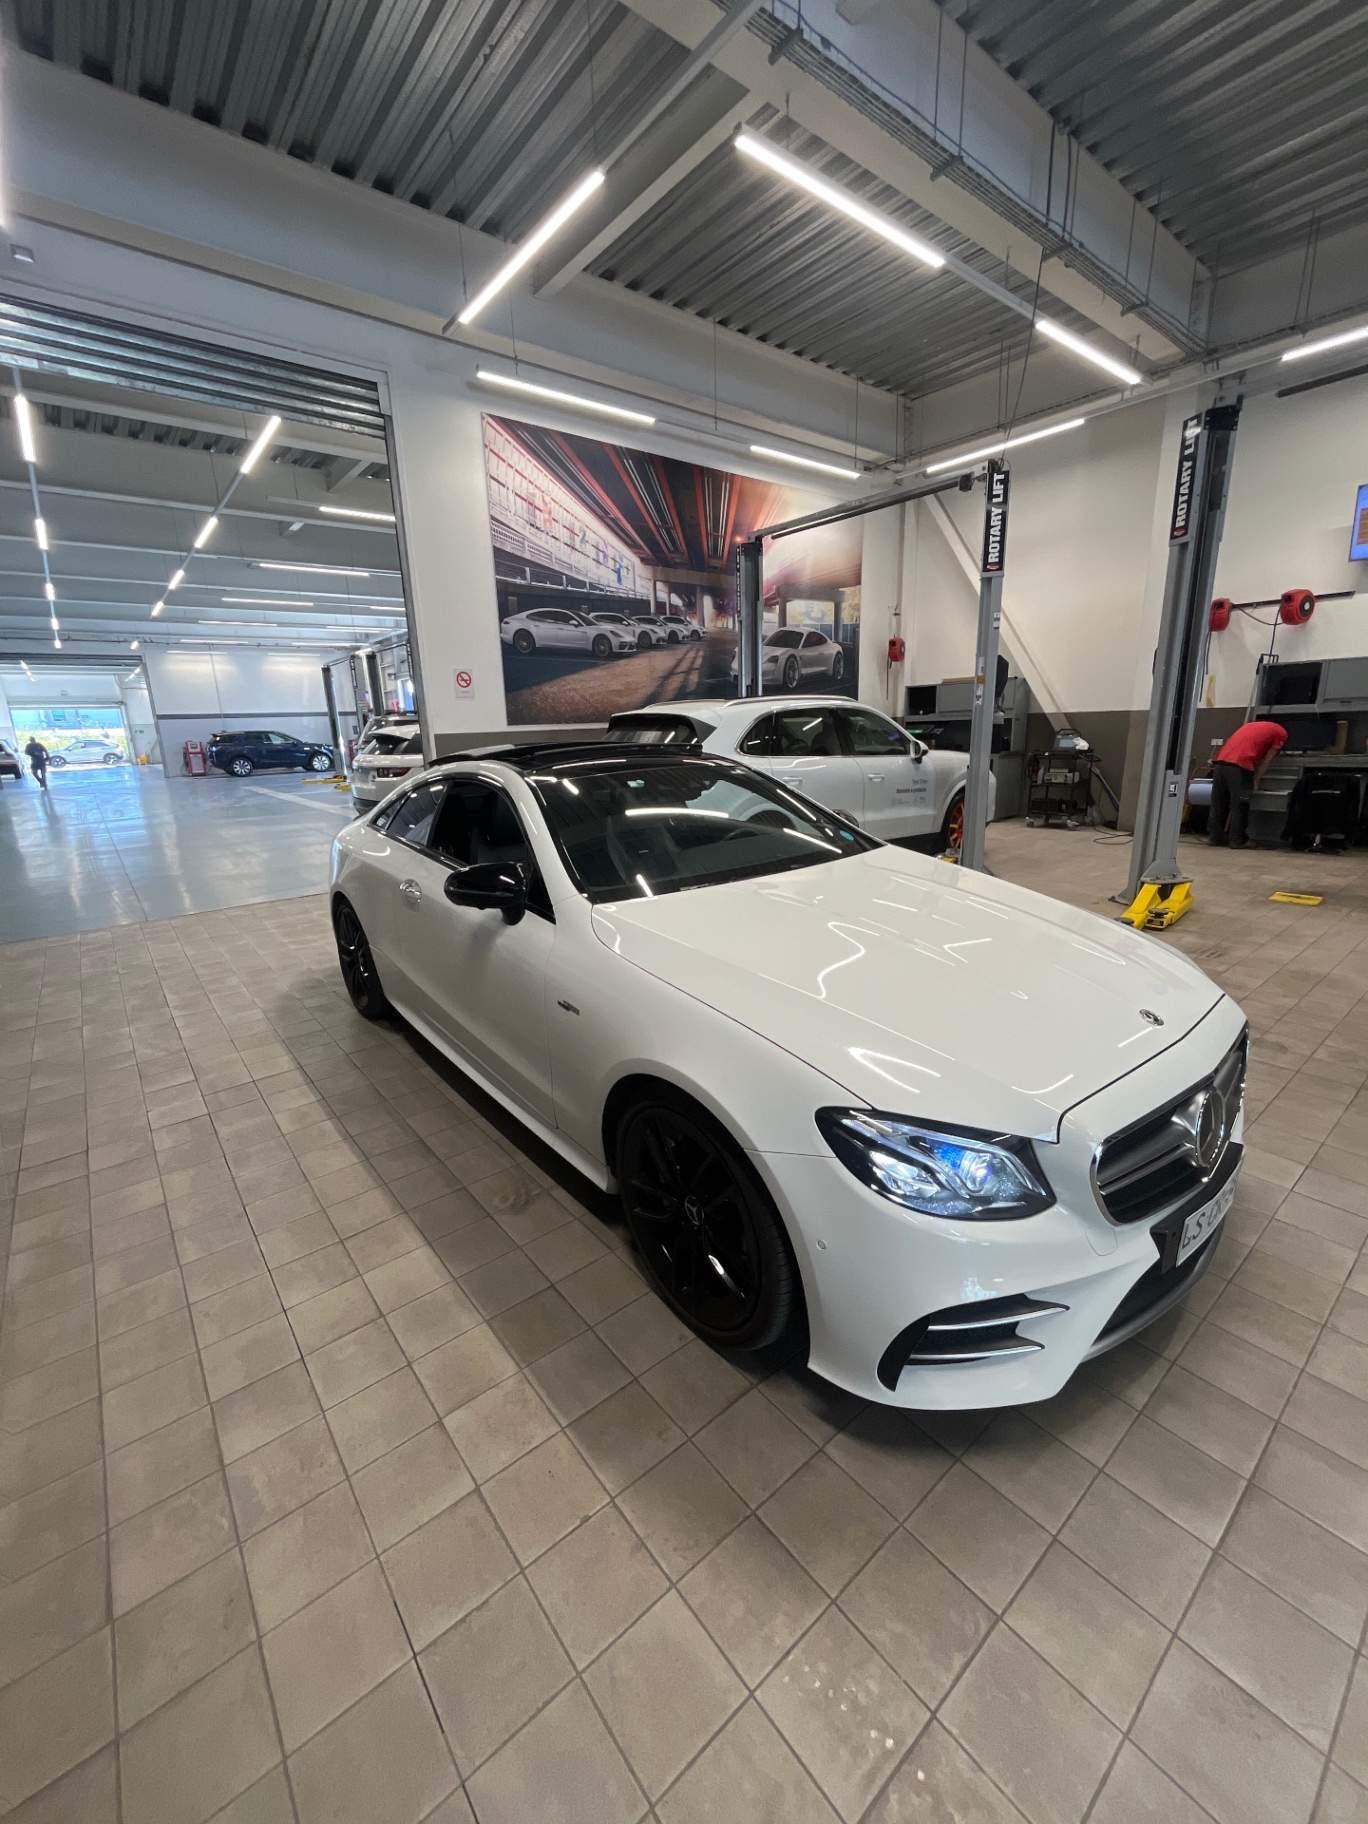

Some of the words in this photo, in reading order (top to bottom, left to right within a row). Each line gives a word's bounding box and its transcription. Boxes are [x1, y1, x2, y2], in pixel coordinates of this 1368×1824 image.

[992, 472, 1005, 503] LIFT
[1175, 460, 1192, 528] ROTARY
[987, 506, 1003, 563] ROTARY
